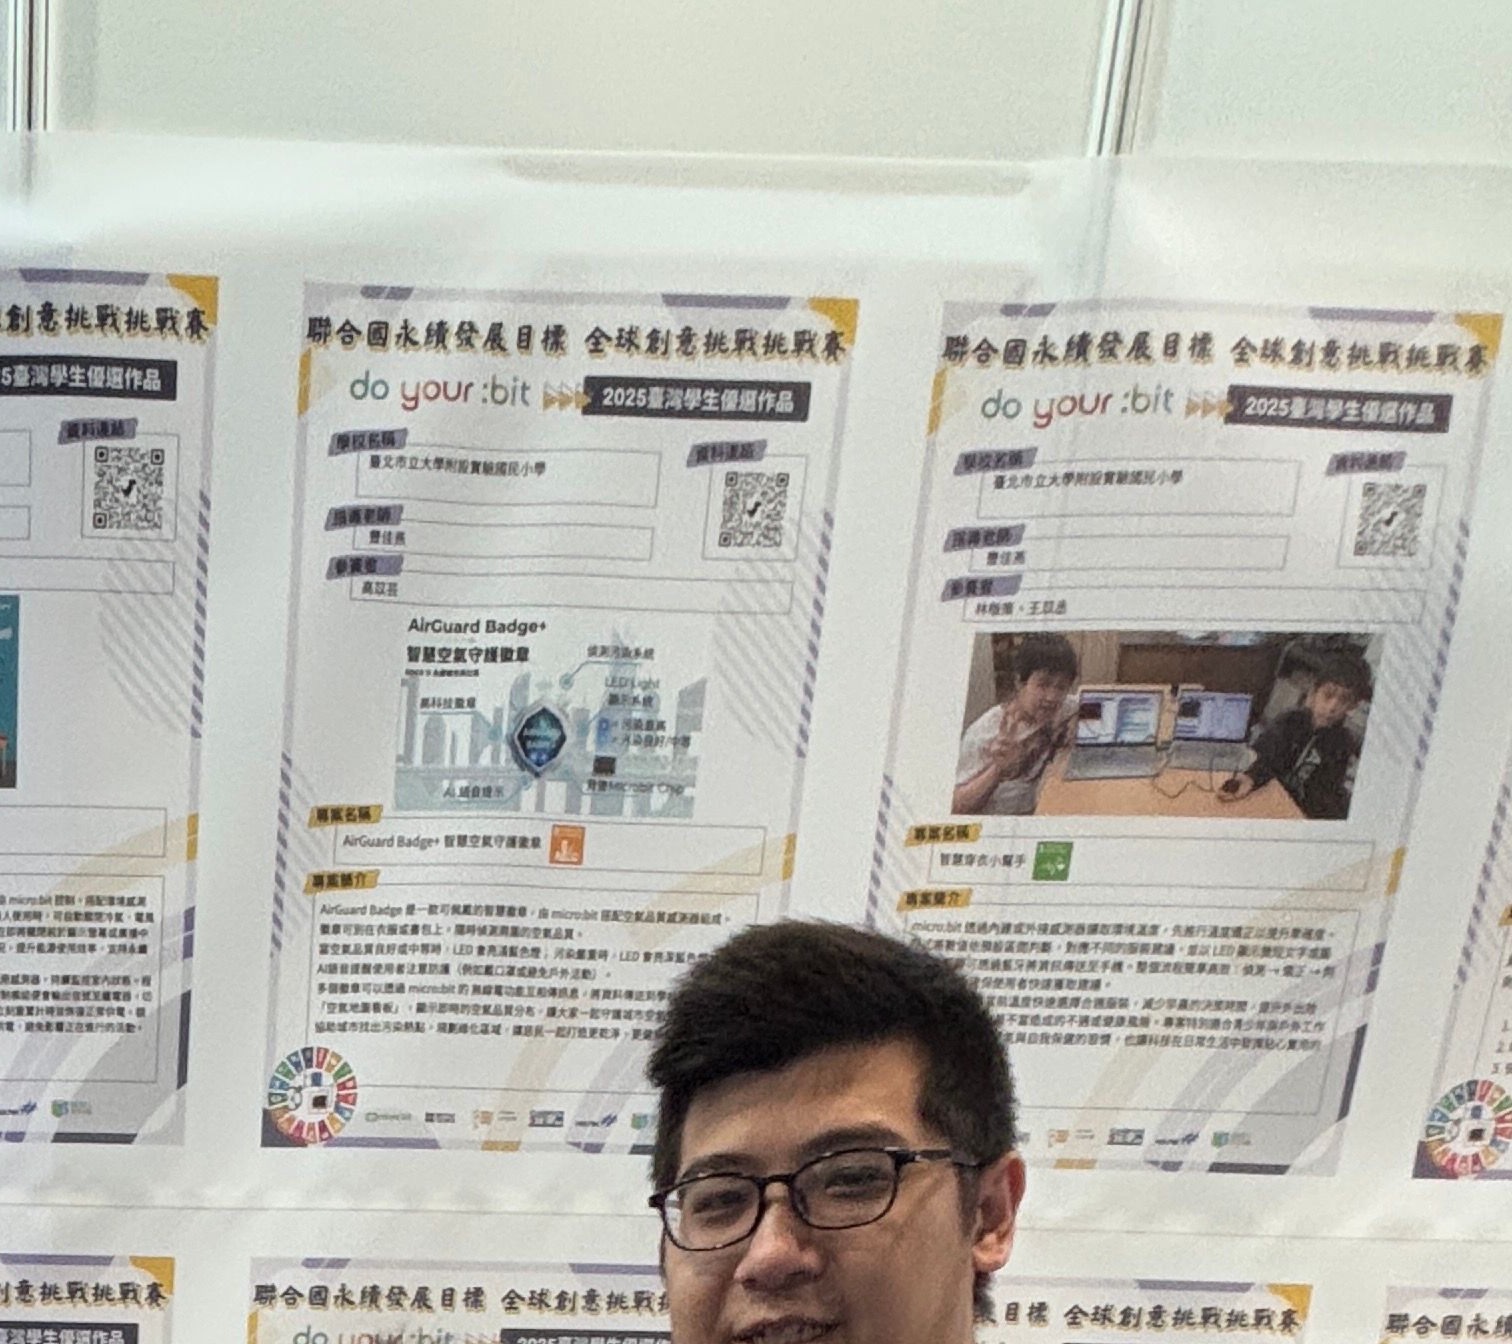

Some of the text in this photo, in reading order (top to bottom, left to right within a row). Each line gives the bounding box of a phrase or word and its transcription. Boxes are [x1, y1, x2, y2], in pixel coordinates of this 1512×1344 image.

[307, 317, 849, 363] 聯合國永續發展目標 全球創意挑戰挑戰賽
[943, 331, 1490, 375] 聯合國永續發展目標 全球創意挑戰挑戰賽
[350, 369, 532, 412] do your :bit
[981, 383, 1174, 429] do your :bit
[408, 618, 480, 636] AirGuard
[342, 835, 394, 849] AirGuard
[320, 904, 367, 916] AirGuard
[253, 1283, 488, 1311] 聯合國永續發展目標
[1064, 1305, 1302, 1337] 全球創意挑戰挑戰賽
